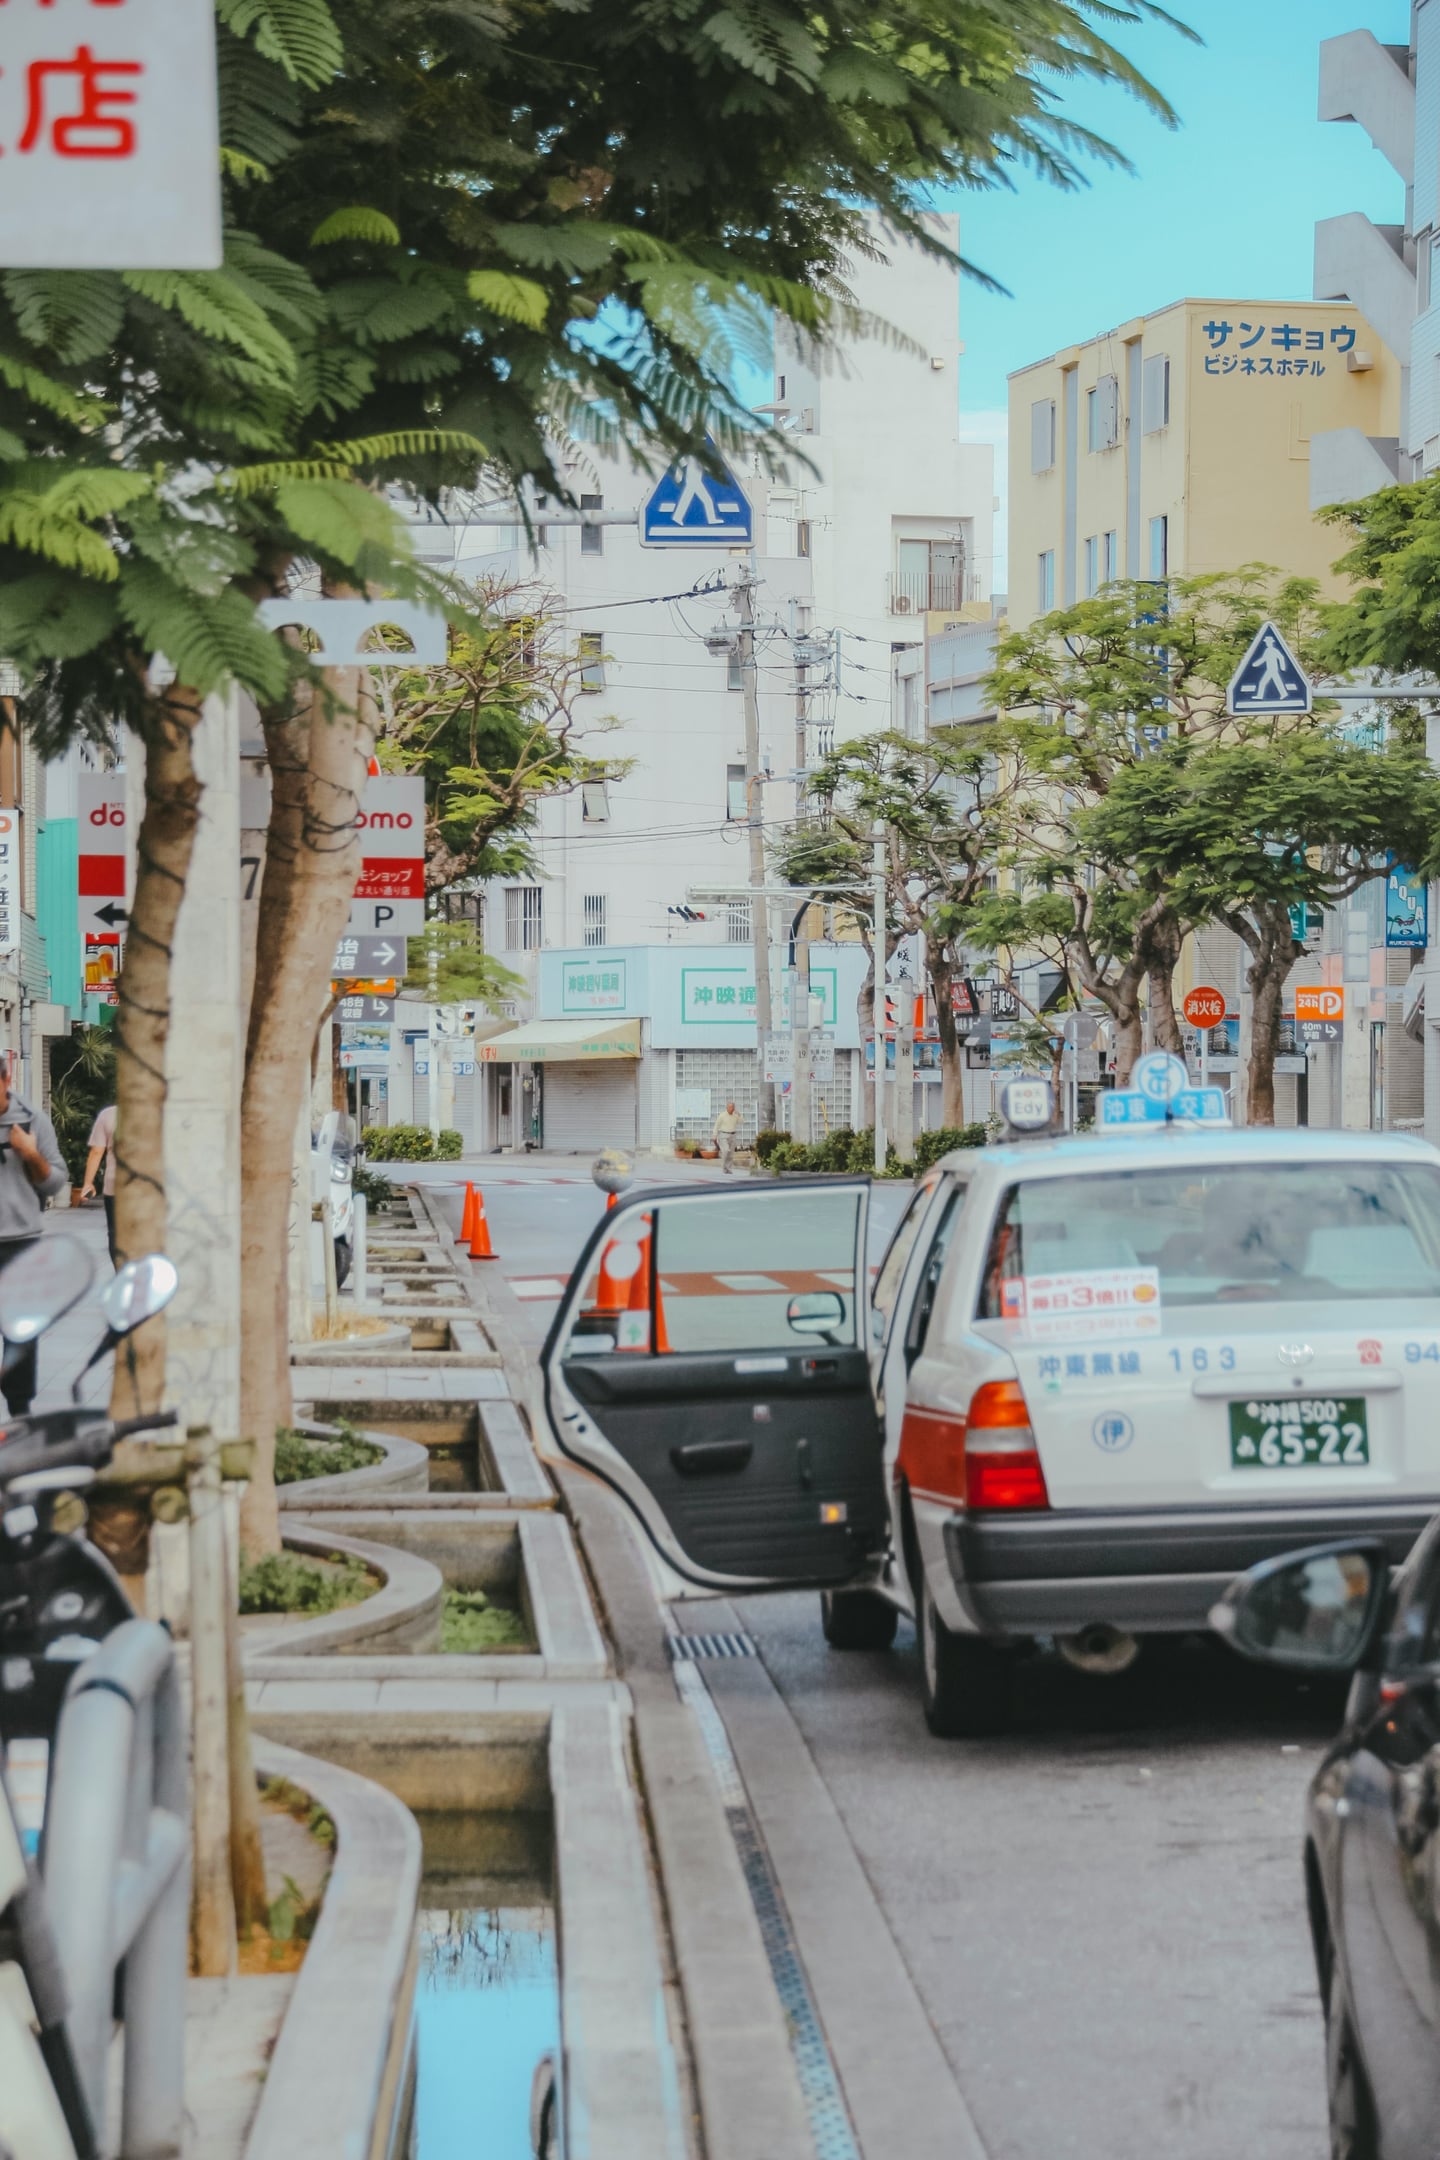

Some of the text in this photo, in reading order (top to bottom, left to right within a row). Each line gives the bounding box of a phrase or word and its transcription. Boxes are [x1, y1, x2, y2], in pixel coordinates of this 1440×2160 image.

[0, 45, 145, 159] 店
[1202, 320, 1356, 353] サンキョウ
[1204, 353, 1326, 377] ビジネスホテル
[89, 802, 125, 826] do
[355, 811, 413, 829] omo
[360, 869, 413, 882] モショップ
[355, 885, 411, 896] きえい通り店
[1389, 875, 1424, 920] AQUA
[374, 905, 394, 928] P
[1187, 999, 1221, 1016] 消火栓
[1297, 998, 1319, 1008] 24h
[1302, 1022, 1321, 1031] 40m
[1303, 1031, 1320, 1040] 手前
[1014, 1101, 1043, 1116] Edy
[1038, 1351, 1142, 1378] 沖東無線
[1258, 1422, 1365, 1465] 65-22
